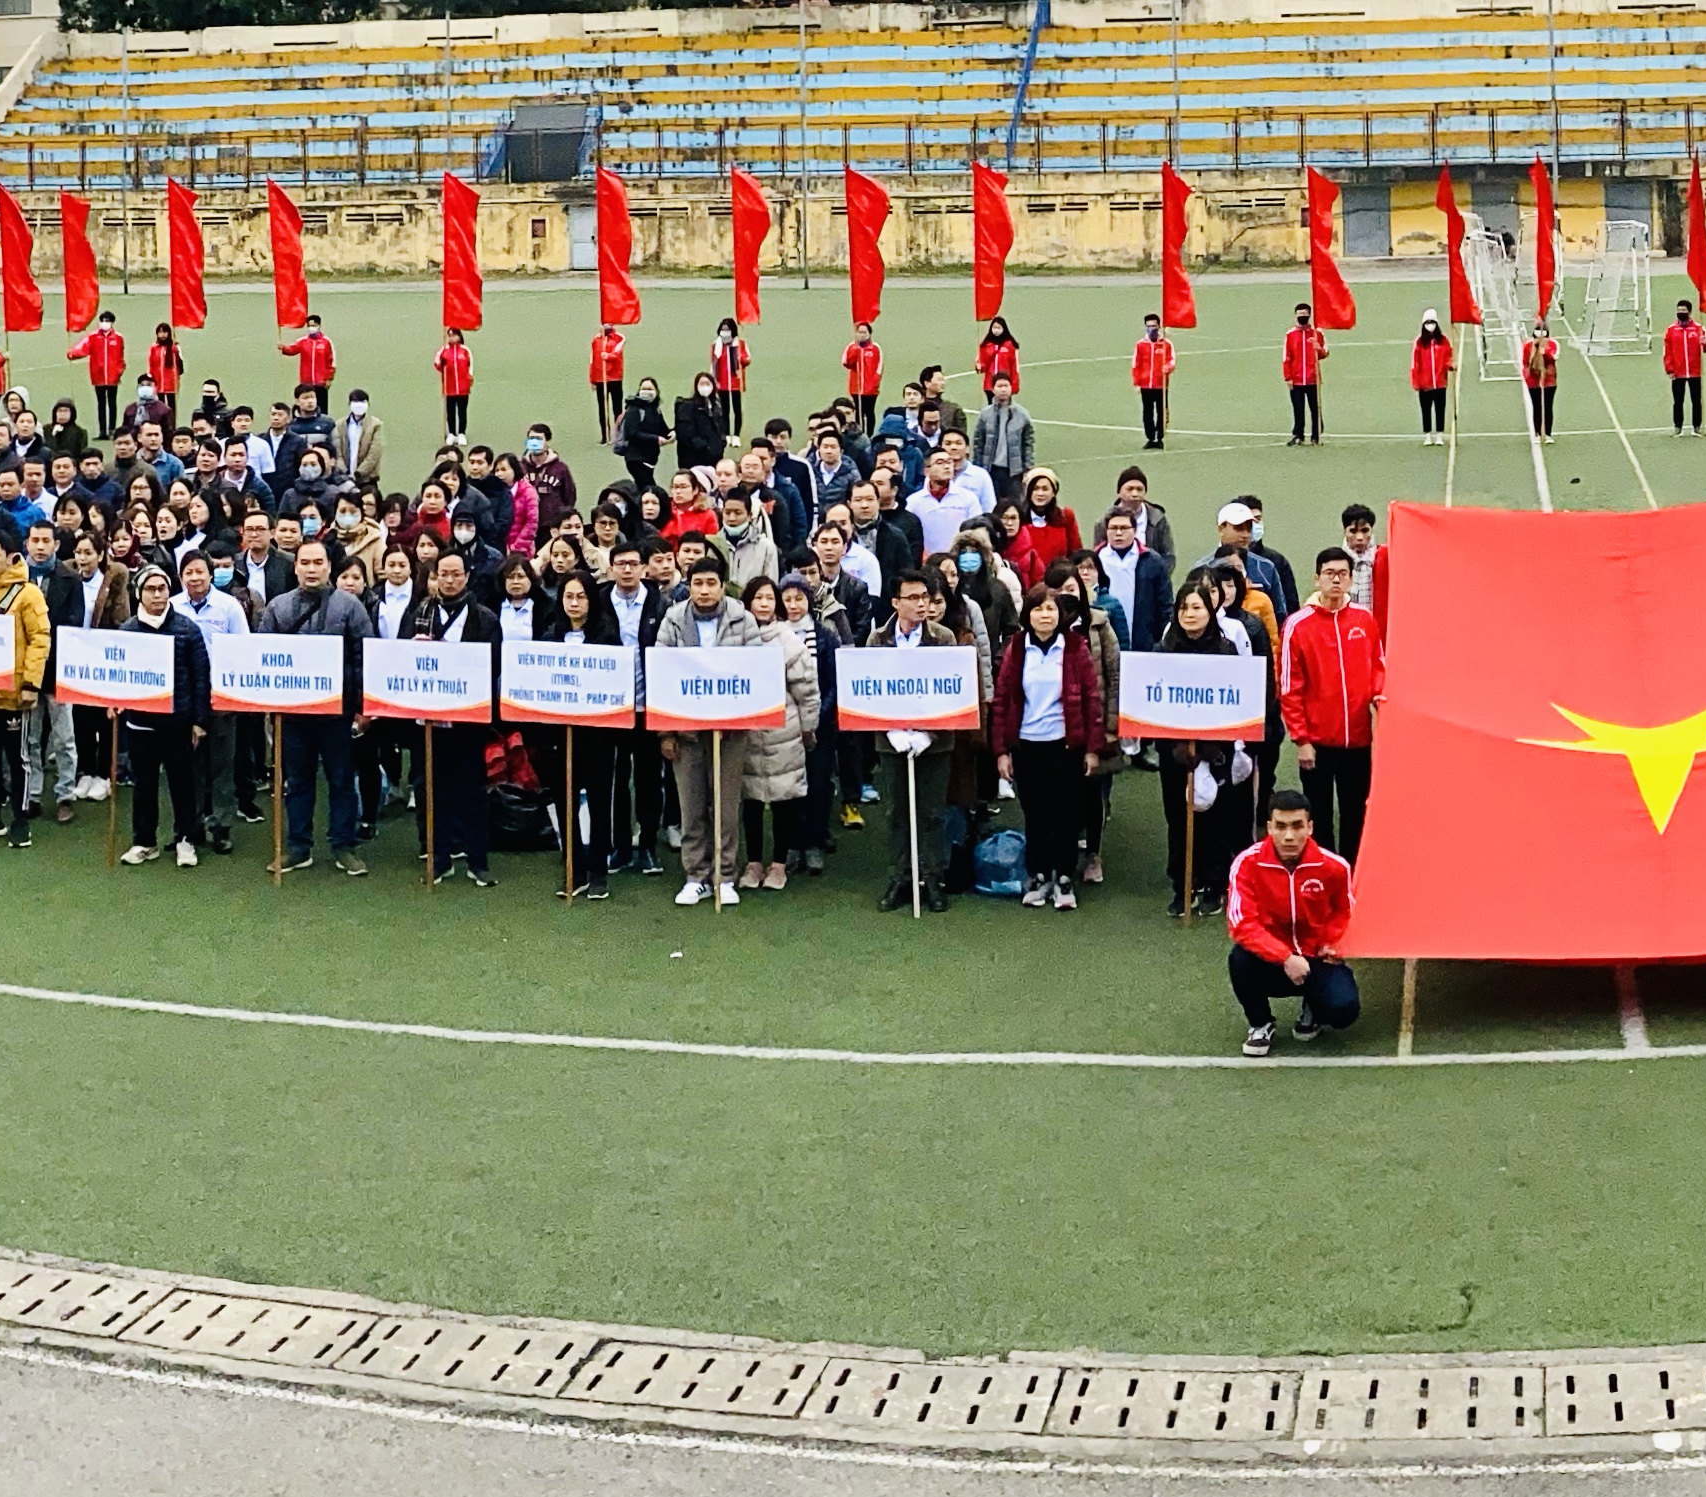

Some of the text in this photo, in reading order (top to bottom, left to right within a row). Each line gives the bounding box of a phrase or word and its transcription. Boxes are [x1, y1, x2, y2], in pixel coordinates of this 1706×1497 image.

[105, 645, 126, 664] VIỆN
[262, 653, 293, 667] KHOA
[416, 654, 438, 674] VIỆN
[517, 653, 535, 667] VIỆN
[569, 656, 580, 668] KH
[583, 655, 597, 671] VẬT
[64, 663, 166, 686] KH VÀ CN MÔI TRƯỜNG
[222, 672, 332, 693] LÝ LUẬN CHÍNH TRỊ
[387, 675, 467, 697] VẬT LÝ KỸ THUẬT
[536, 690, 561, 702] THANH
[564, 692, 578, 703] TRA
[681, 675, 750, 699] VIỆN ĐIỆN
[852, 674, 962, 700] VIỆN NGOẠI NGỮ
[1146, 678, 1240, 708] TỔ TRỌNG TÀI
